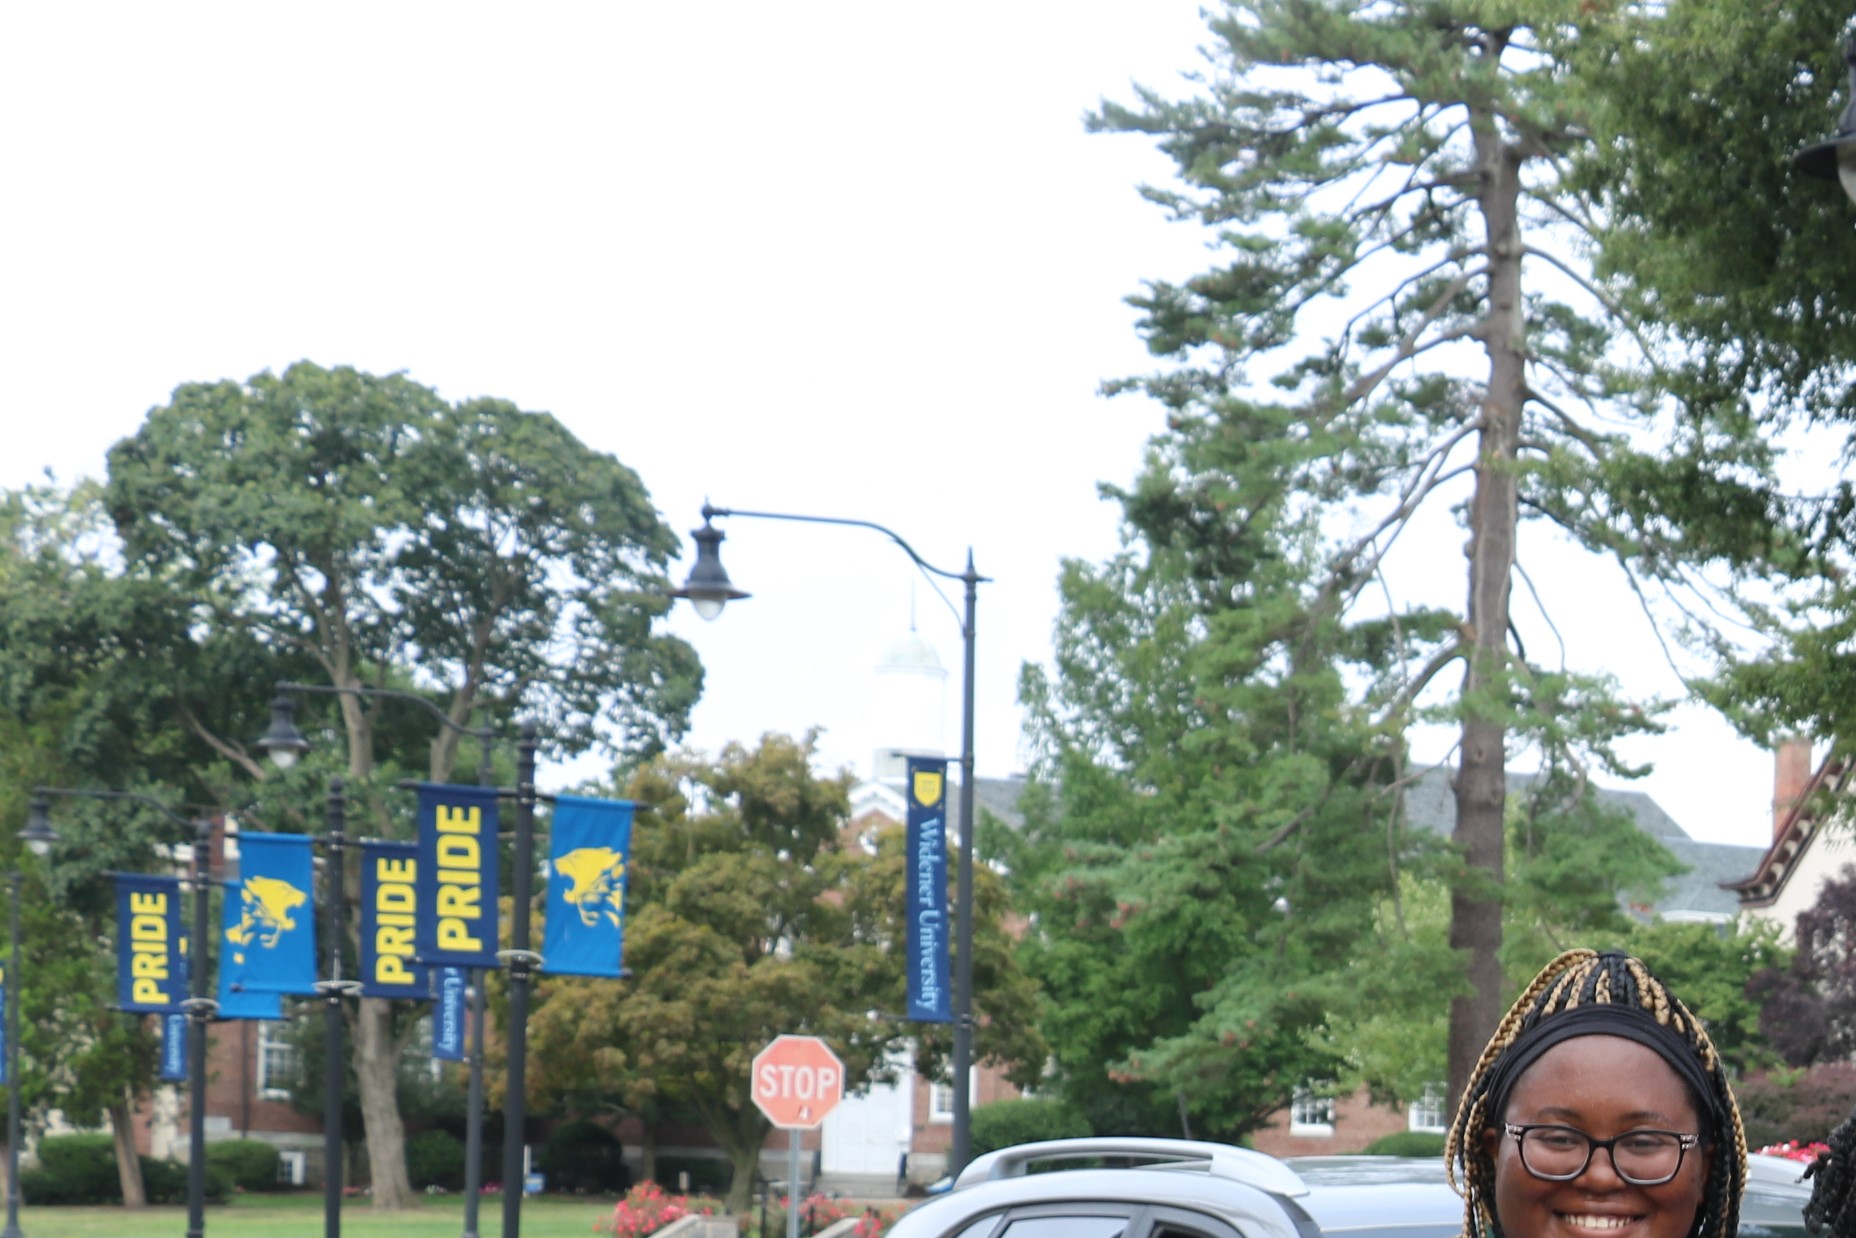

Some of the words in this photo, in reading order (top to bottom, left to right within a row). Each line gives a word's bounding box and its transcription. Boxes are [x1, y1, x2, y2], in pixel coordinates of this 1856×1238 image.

[435, 804, 483, 952] PRIDE
[917, 816, 942, 908] Widener
[130, 891, 170, 1004] PRIDE
[375, 857, 417, 985] PRIDE
[914, 910, 940, 1013] University
[758, 1063, 837, 1102] STOP
